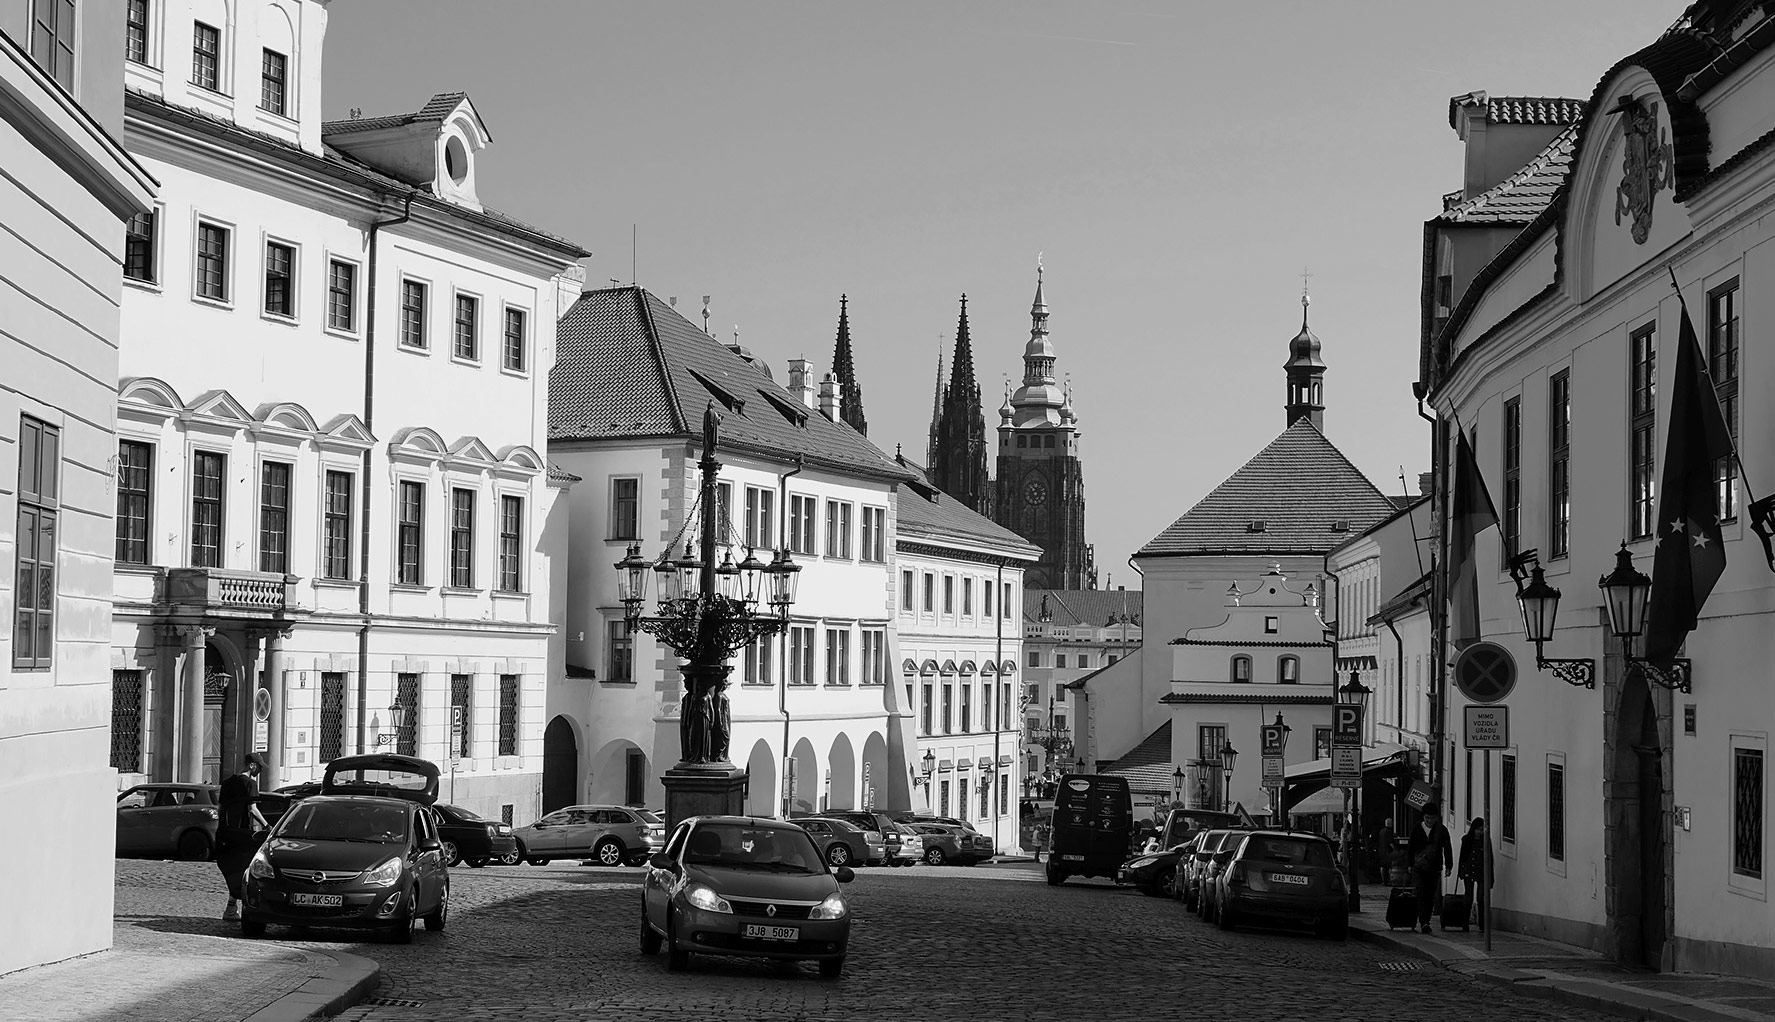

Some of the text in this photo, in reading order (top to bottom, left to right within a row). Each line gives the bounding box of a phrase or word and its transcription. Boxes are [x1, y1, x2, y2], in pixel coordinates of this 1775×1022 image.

[454, 709, 461, 725] P
[1338, 709, 1356, 733] P
[1265, 729, 1279, 747] P
[1412, 790, 1425, 799] HOT
[1289, 875, 1305, 884] 0404
[294, 894, 306, 904] LC
[749, 925, 795, 938] 3J8 5087
